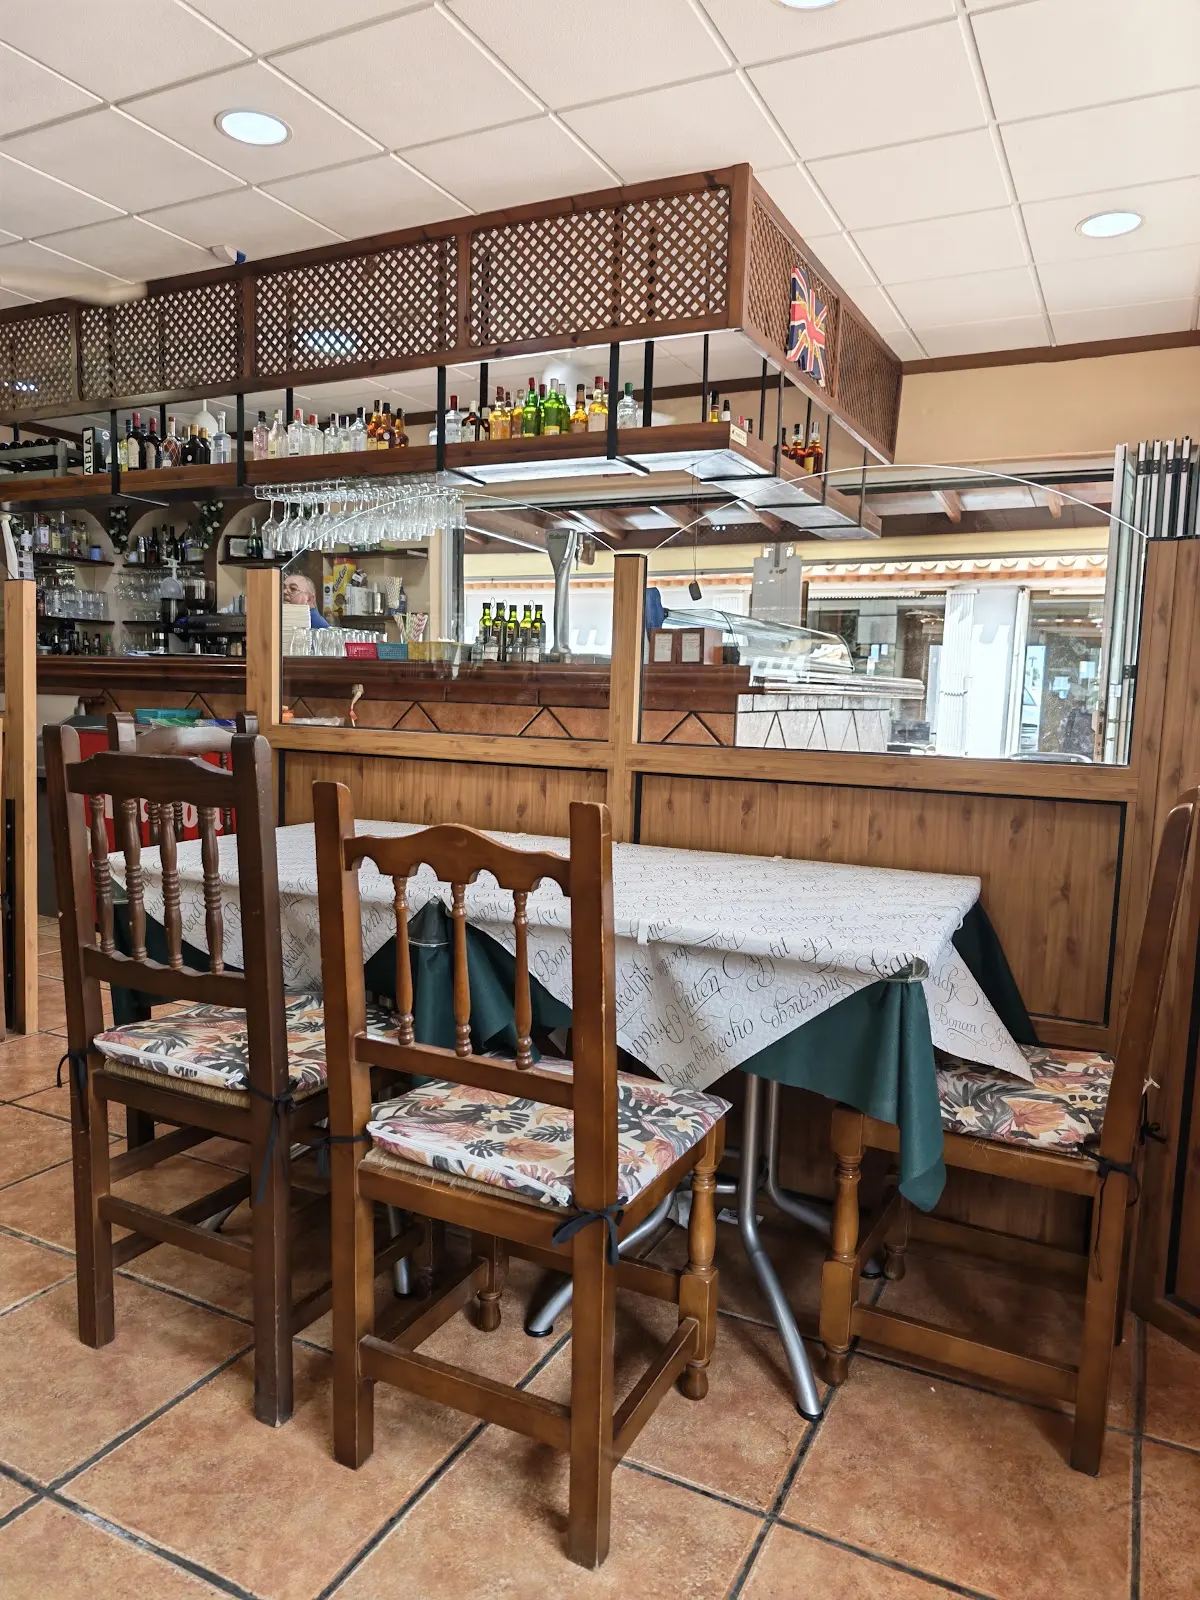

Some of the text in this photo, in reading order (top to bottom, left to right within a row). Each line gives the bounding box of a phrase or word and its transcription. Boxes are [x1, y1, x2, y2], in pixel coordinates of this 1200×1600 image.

[534, 945, 571, 983] Bon
[615, 949, 654, 1017] kelijk
[672, 967, 734, 1026] Guten
[760, 973, 857, 1029] Smacznego
[934, 1002, 978, 1034] Bonan
[690, 1003, 754, 1071] Provecho
